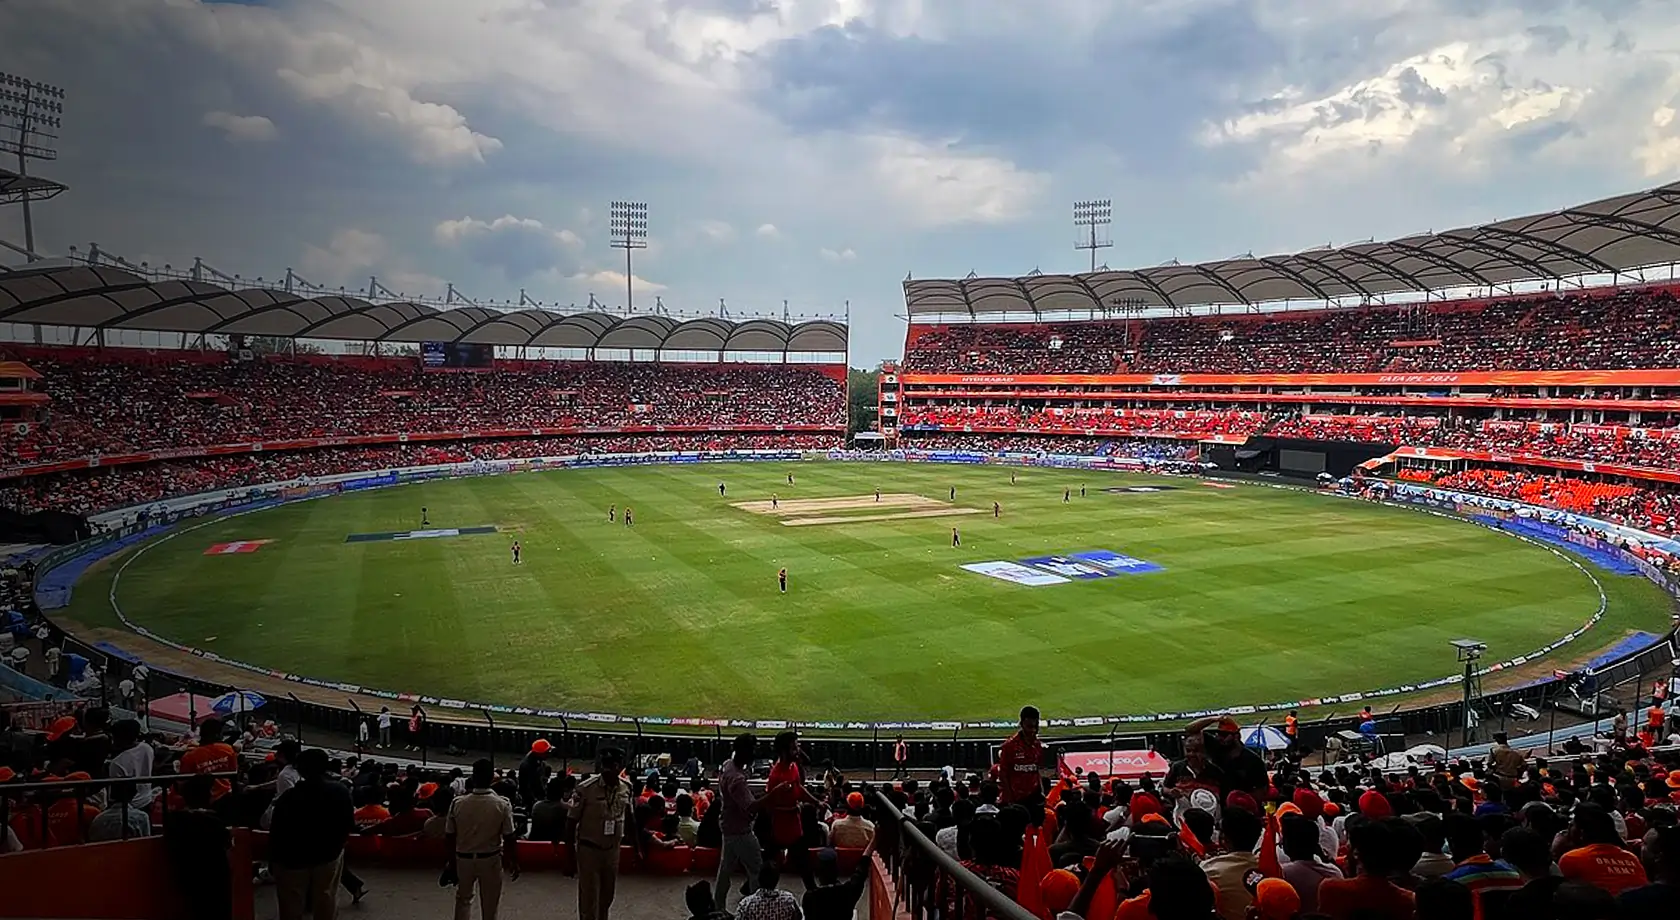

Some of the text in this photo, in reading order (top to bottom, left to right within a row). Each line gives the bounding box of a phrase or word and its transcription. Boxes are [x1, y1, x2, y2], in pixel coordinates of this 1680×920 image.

[1405, 375, 1422, 383] IPL
[1425, 375, 1459, 383] 2024
[1595, 856, 1636, 868] ORANGE
[1606, 866, 1637, 876] ARMY
